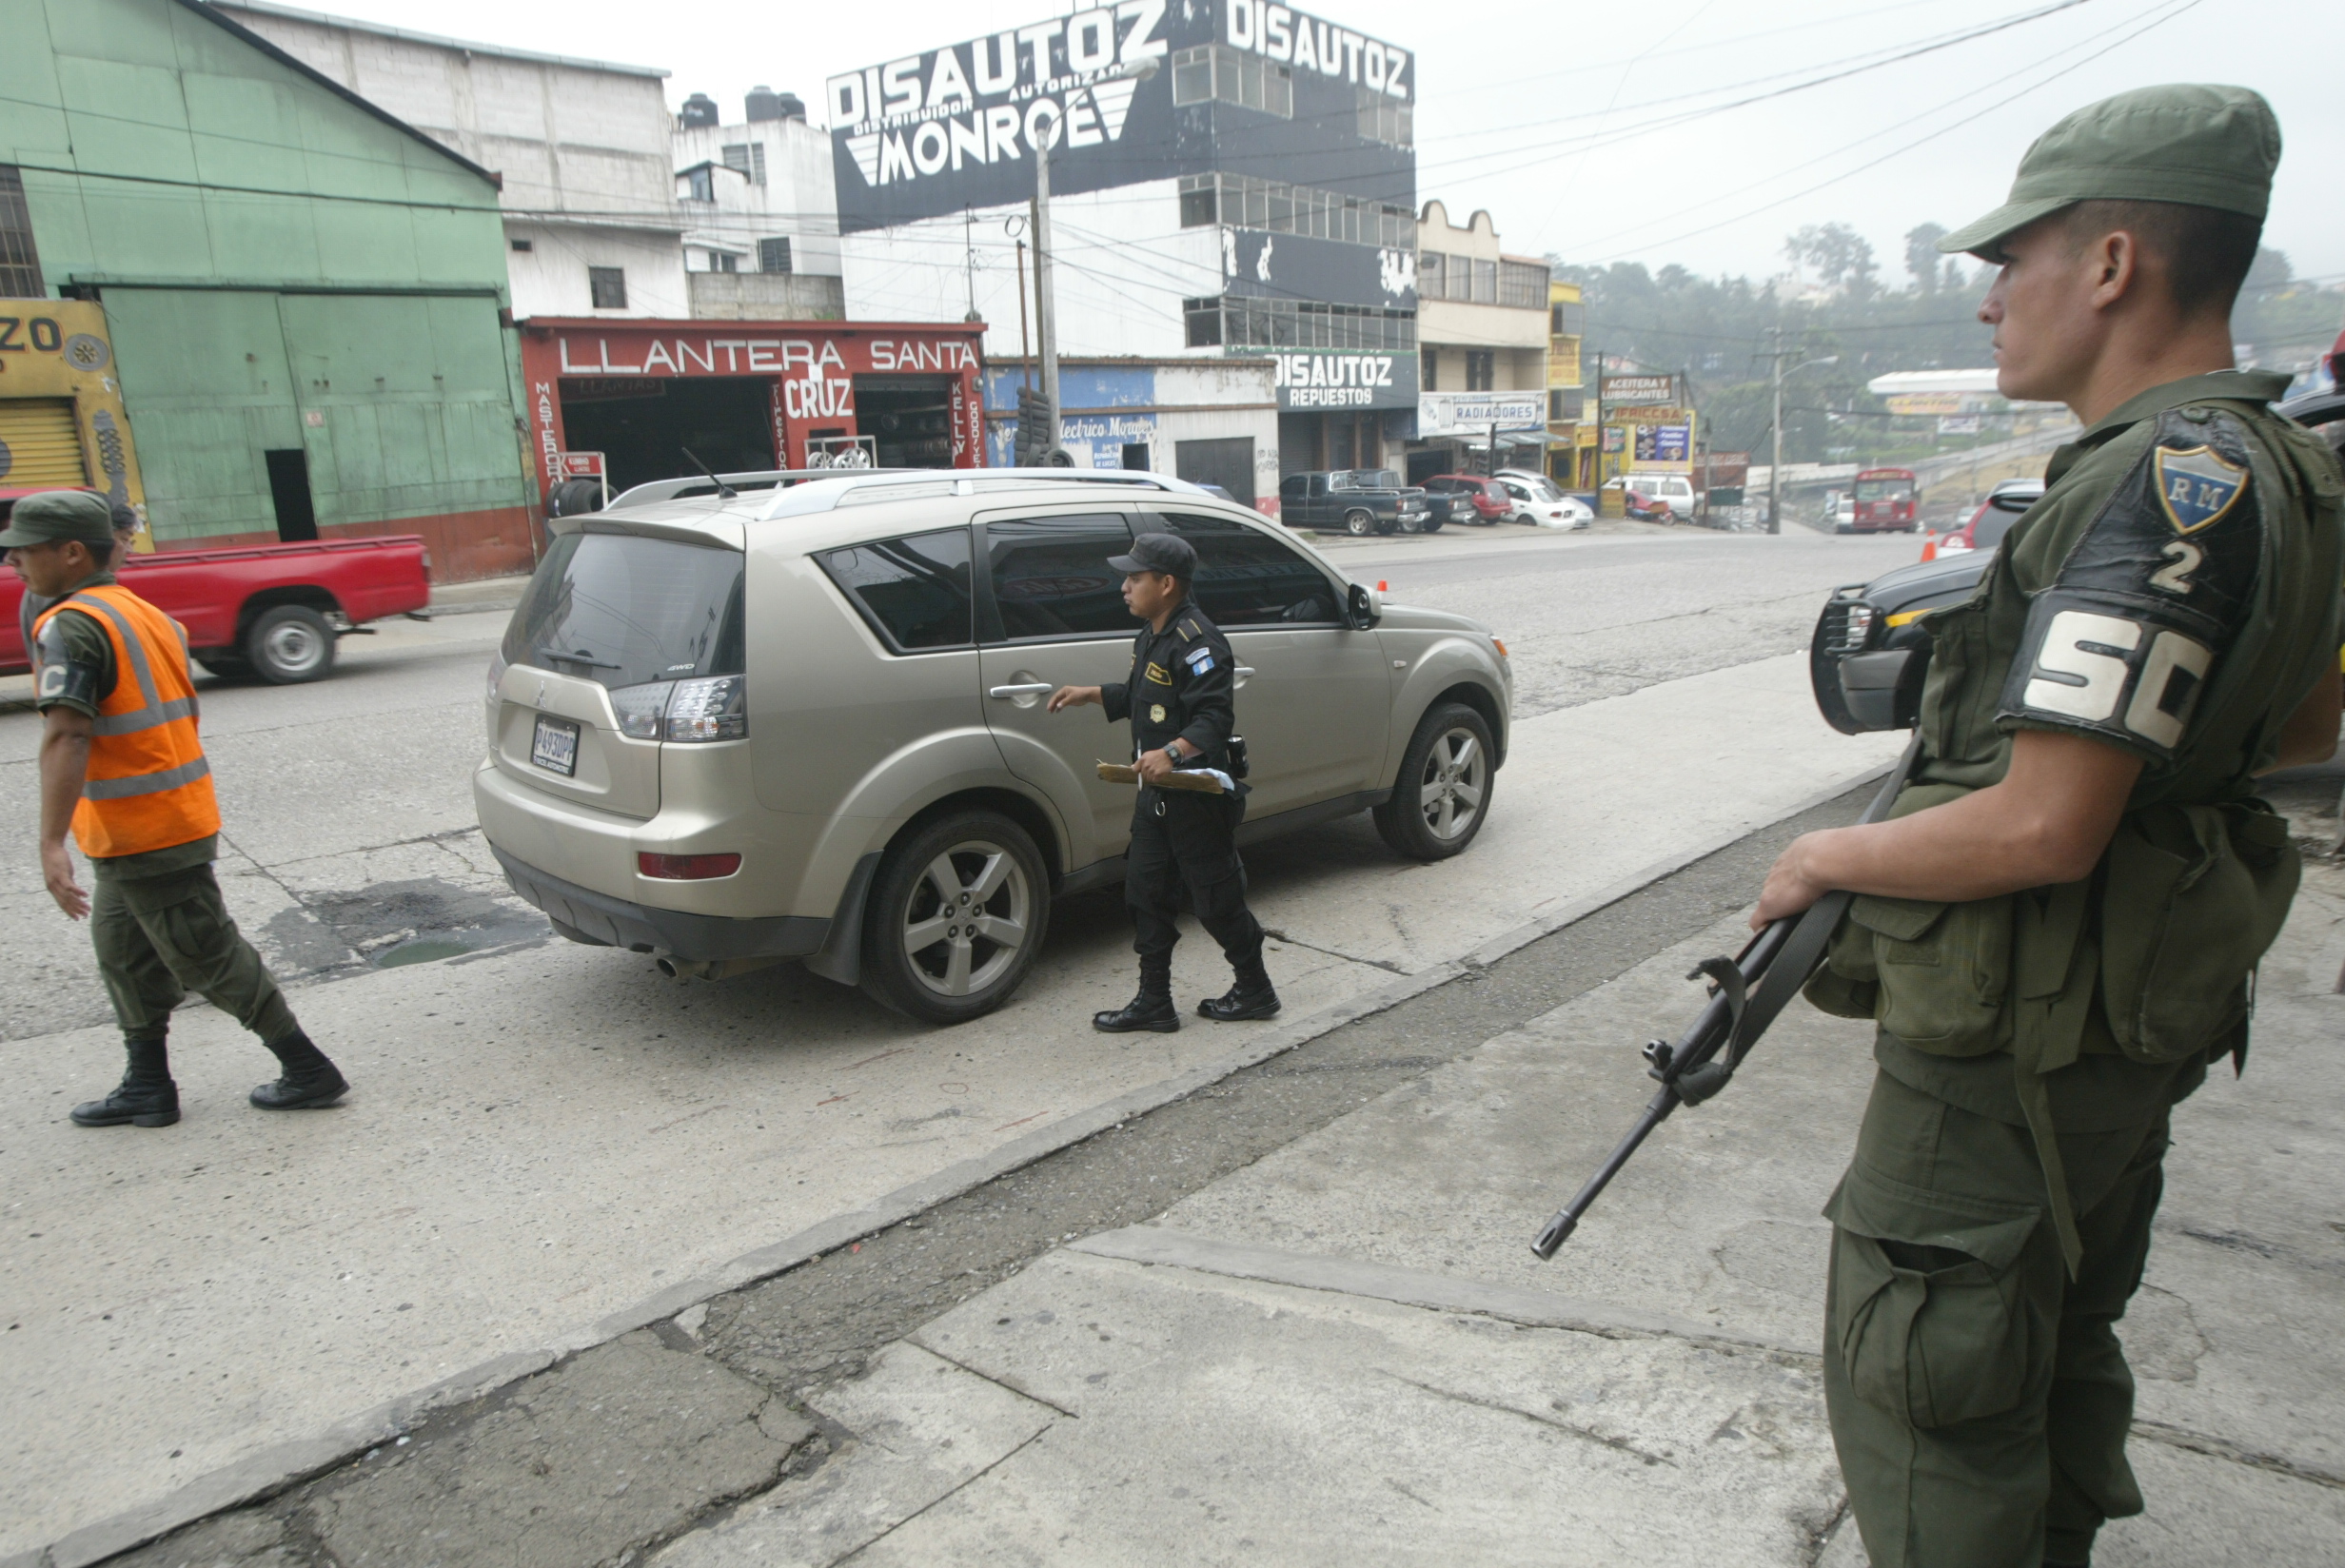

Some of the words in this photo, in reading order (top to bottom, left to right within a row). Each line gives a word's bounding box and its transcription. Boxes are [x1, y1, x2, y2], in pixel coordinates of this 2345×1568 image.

[826, 0, 1168, 130] DISAUTOZ
[1227, 0, 1407, 99] DISAUTOZ
[1009, 64, 1123, 103] AUTORIZAD
[854, 99, 974, 136] DISTRIBUIDOR
[879, 87, 1103, 186] MONROE
[559, 339, 845, 375] LLANTERA
[870, 340, 977, 371] SANTA
[1264, 354, 1392, 387] DISAUTOZ
[784, 379, 853, 419] CRUZ
[1290, 388, 1372, 407] REPUESTOS
[1602, 389, 1670, 400] LUBRICANTES
[1608, 378, 1658, 389] ACEITERA
[1660, 377, 1668, 388] Y
[952, 382, 966, 454] KELLY
[1059, 419, 1105, 440] lectrico
[1456, 406, 1532, 419] RADIADORES
[2148, 540, 2203, 595] 2
[2023, 610, 2214, 749] SC
